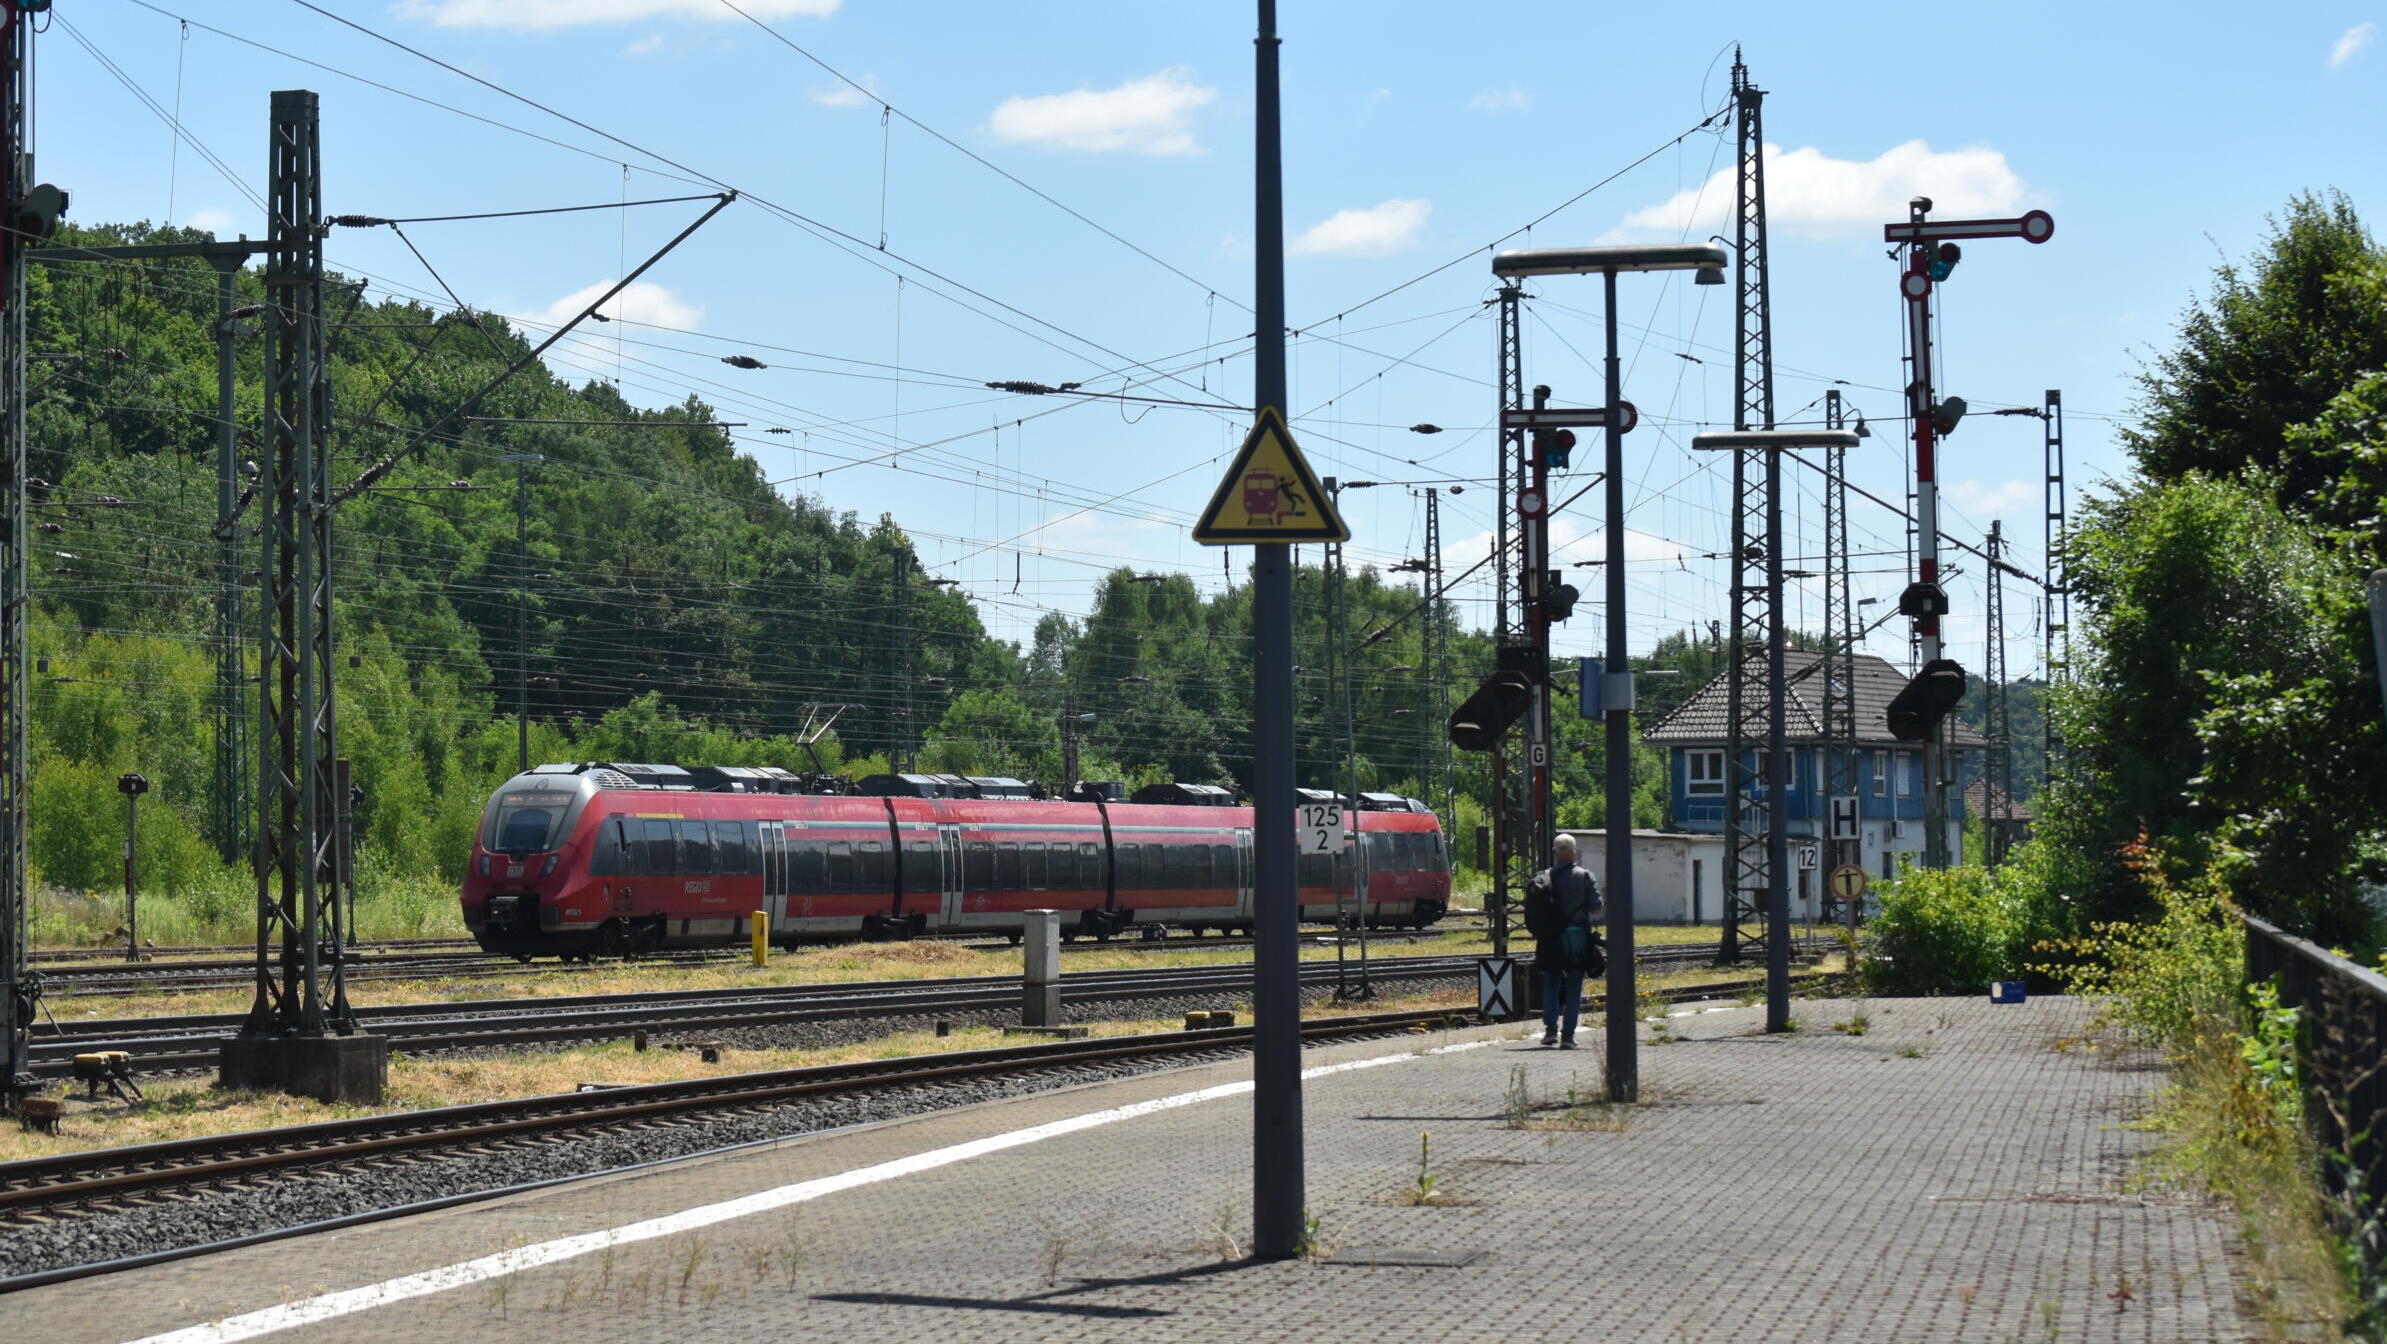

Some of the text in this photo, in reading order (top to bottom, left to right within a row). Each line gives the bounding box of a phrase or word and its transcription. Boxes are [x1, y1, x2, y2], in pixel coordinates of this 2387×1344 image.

[1533, 747, 1543, 763] G
[1304, 805, 1339, 828] 125
[1834, 799, 1856, 836] H
[1316, 829, 1328, 850] 2
[1800, 849, 1816, 867] 12
